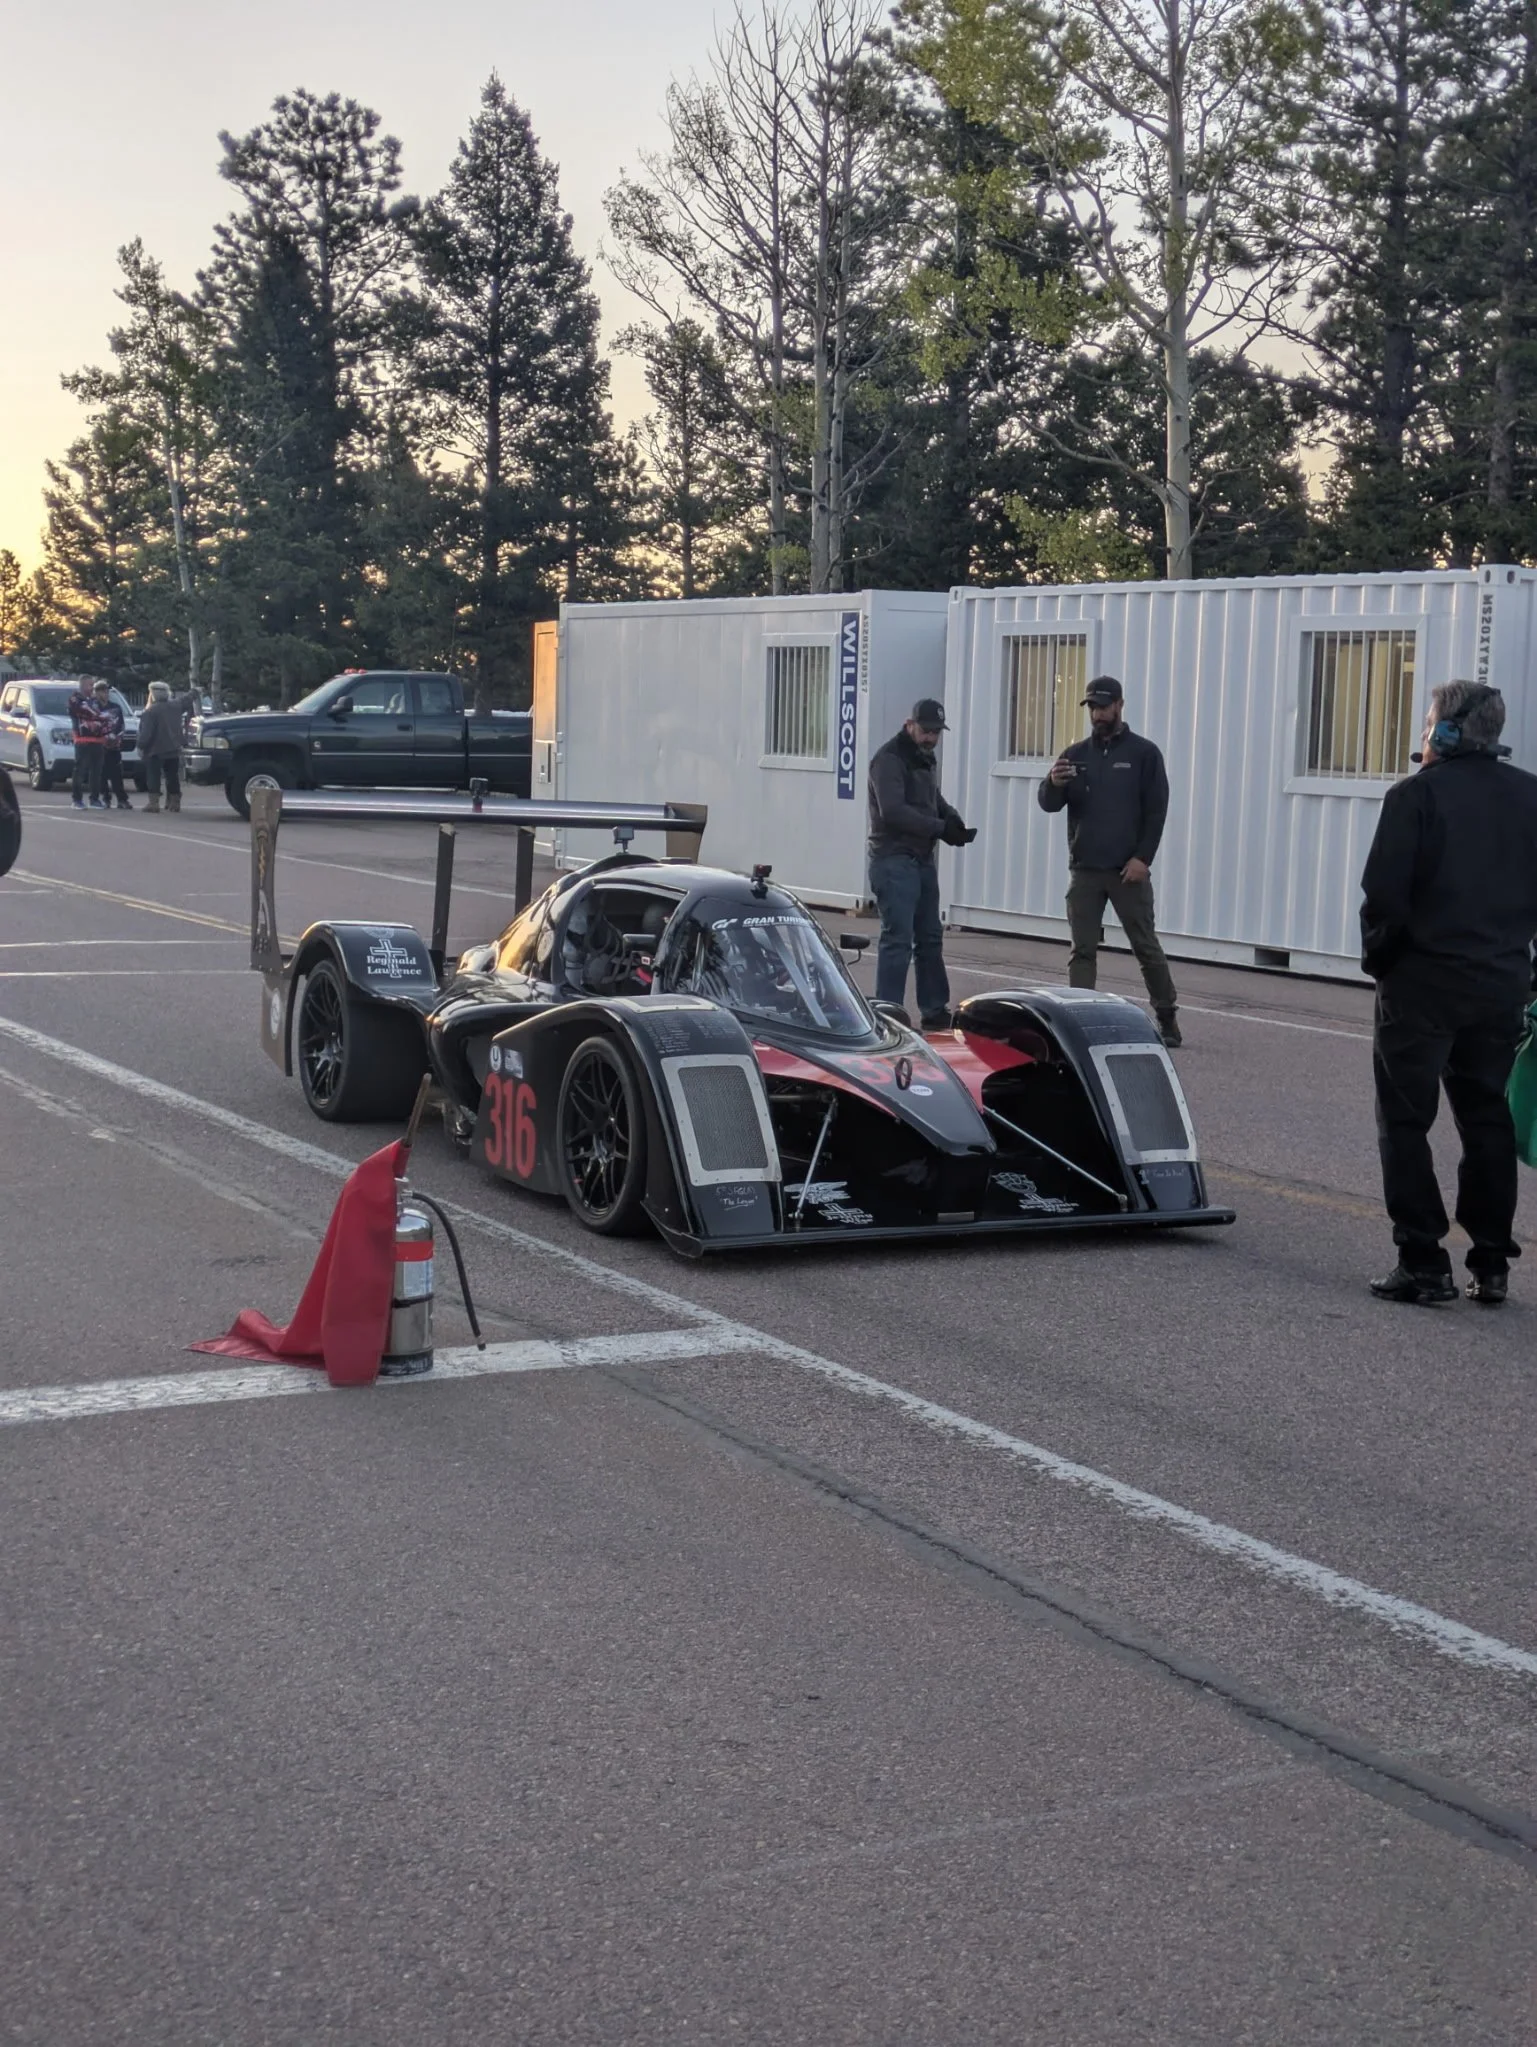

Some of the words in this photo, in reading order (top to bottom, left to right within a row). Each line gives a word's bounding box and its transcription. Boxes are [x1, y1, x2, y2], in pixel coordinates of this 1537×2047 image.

[840, 620, 856, 791] WILLSCOT
[743, 916, 774, 924] GRAN
[366, 955, 417, 965] Reginald
[367, 966, 422, 975] Lawrence
[484, 1071, 537, 1179] 316
